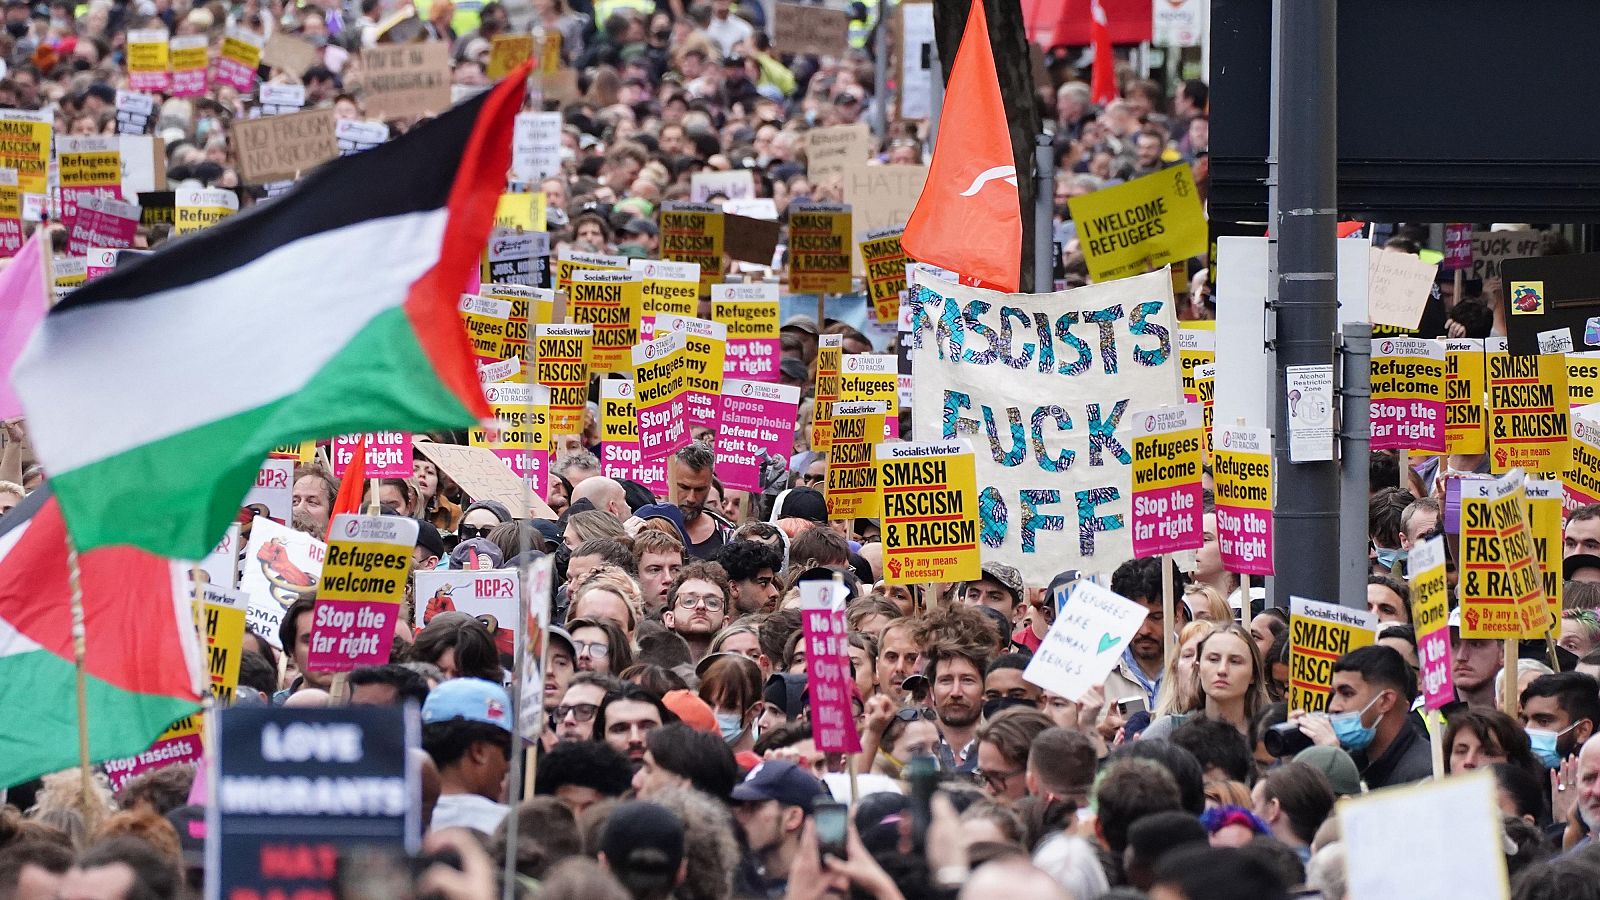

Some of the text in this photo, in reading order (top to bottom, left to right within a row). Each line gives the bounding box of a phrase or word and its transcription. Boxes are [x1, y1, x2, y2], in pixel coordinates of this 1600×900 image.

[62, 156, 118, 170] Refugees
[62, 170, 116, 180] welcome
[664, 215, 704, 228] SMASH
[792, 216, 832, 229] SMASH
[1083, 197, 1168, 238] I WELCOME
[664, 236, 714, 250] FASCISM
[792, 236, 841, 250] FASCISM
[1089, 218, 1164, 256] REFUGEES
[804, 255, 849, 268] RACISM
[584, 274, 611, 282] Socialist
[492, 288, 520, 296] Socialist
[576, 285, 622, 302] SMASH
[642, 282, 696, 300] efugees
[574, 307, 630, 324] FASCISM
[643, 300, 692, 314] elcome
[716, 305, 776, 320] Refugees
[546, 328, 573, 336] Socialist
[727, 321, 773, 332] elcome
[912, 283, 1171, 376] FASCISTS
[539, 340, 582, 358] SMASH
[749, 341, 773, 356] the
[1406, 348, 1430, 357] RACISM
[1418, 342, 1426, 350] UP
[636, 356, 684, 384] Refugees
[740, 358, 772, 374] right
[1370, 360, 1442, 378] Refugees
[1490, 356, 1538, 378] SMASH
[1370, 378, 1438, 395] welcome
[1492, 384, 1554, 408] FASCISM
[692, 406, 716, 419] right
[724, 398, 764, 412] Oppose
[1370, 402, 1436, 421] Stop the
[494, 408, 546, 428] fugees
[640, 402, 683, 428] Stop the
[722, 412, 792, 430] Islamophobia
[1157, 410, 1184, 422] STAND UP
[1158, 418, 1187, 430] TO RACISM
[642, 418, 684, 448] far right
[720, 424, 778, 442] Defend the
[832, 418, 866, 439] SMASH
[942, 389, 1132, 473] FUCK
[1370, 421, 1436, 440] far right
[1494, 414, 1568, 438] & RACISM
[378, 430, 403, 445] the
[718, 438, 758, 452] right to
[1238, 442, 1259, 450] RACISM
[338, 448, 404, 468] fa right
[605, 444, 641, 464] Stop
[831, 442, 872, 463] FASCISM
[892, 446, 960, 457] Socialist Worker
[1136, 438, 1198, 461] Refugees
[1510, 447, 1550, 457] By means
[516, 454, 540, 470] the
[716, 453, 756, 466] protest
[1215, 454, 1270, 480] Refugees
[1510, 459, 1539, 468] necessary
[604, 464, 664, 484] far right
[829, 467, 878, 490] & RACISM
[882, 460, 947, 486] SMASH
[1136, 461, 1196, 484] welcome
[1216, 480, 1267, 502] welcome
[884, 490, 962, 517] FASCISM
[1135, 490, 1194, 517] Stop the
[361, 520, 395, 530] STAND UP
[978, 486, 1124, 556] OFF
[1134, 513, 1194, 541] far right
[1218, 509, 1266, 536] Stop the
[370, 530, 397, 540] RACISM
[886, 520, 976, 548] & RACISM
[1220, 534, 1232, 554] far
[1235, 535, 1266, 562] right
[328, 545, 407, 572] Refugees
[904, 556, 958, 568] By any means
[904, 568, 944, 578] necessary
[324, 572, 396, 594] welcome
[475, 578, 501, 598] RCP
[1466, 571, 1480, 596] &
[1079, 590, 1128, 619] REFUGEES
[1482, 608, 1510, 620] By any
[316, 604, 386, 632] Stop the
[810, 613, 829, 632] No
[1066, 614, 1091, 630] ARE
[1304, 606, 1366, 626] Socialist Worker
[312, 631, 380, 658] far right
[813, 636, 826, 656] is
[1054, 630, 1088, 653] HUMAN
[1293, 620, 1350, 654] SMASH
[1039, 650, 1082, 676] BEINGS
[1292, 686, 1298, 710] &
[261, 721, 363, 763] LOVE
[221, 775, 405, 816] MIGRANTS
